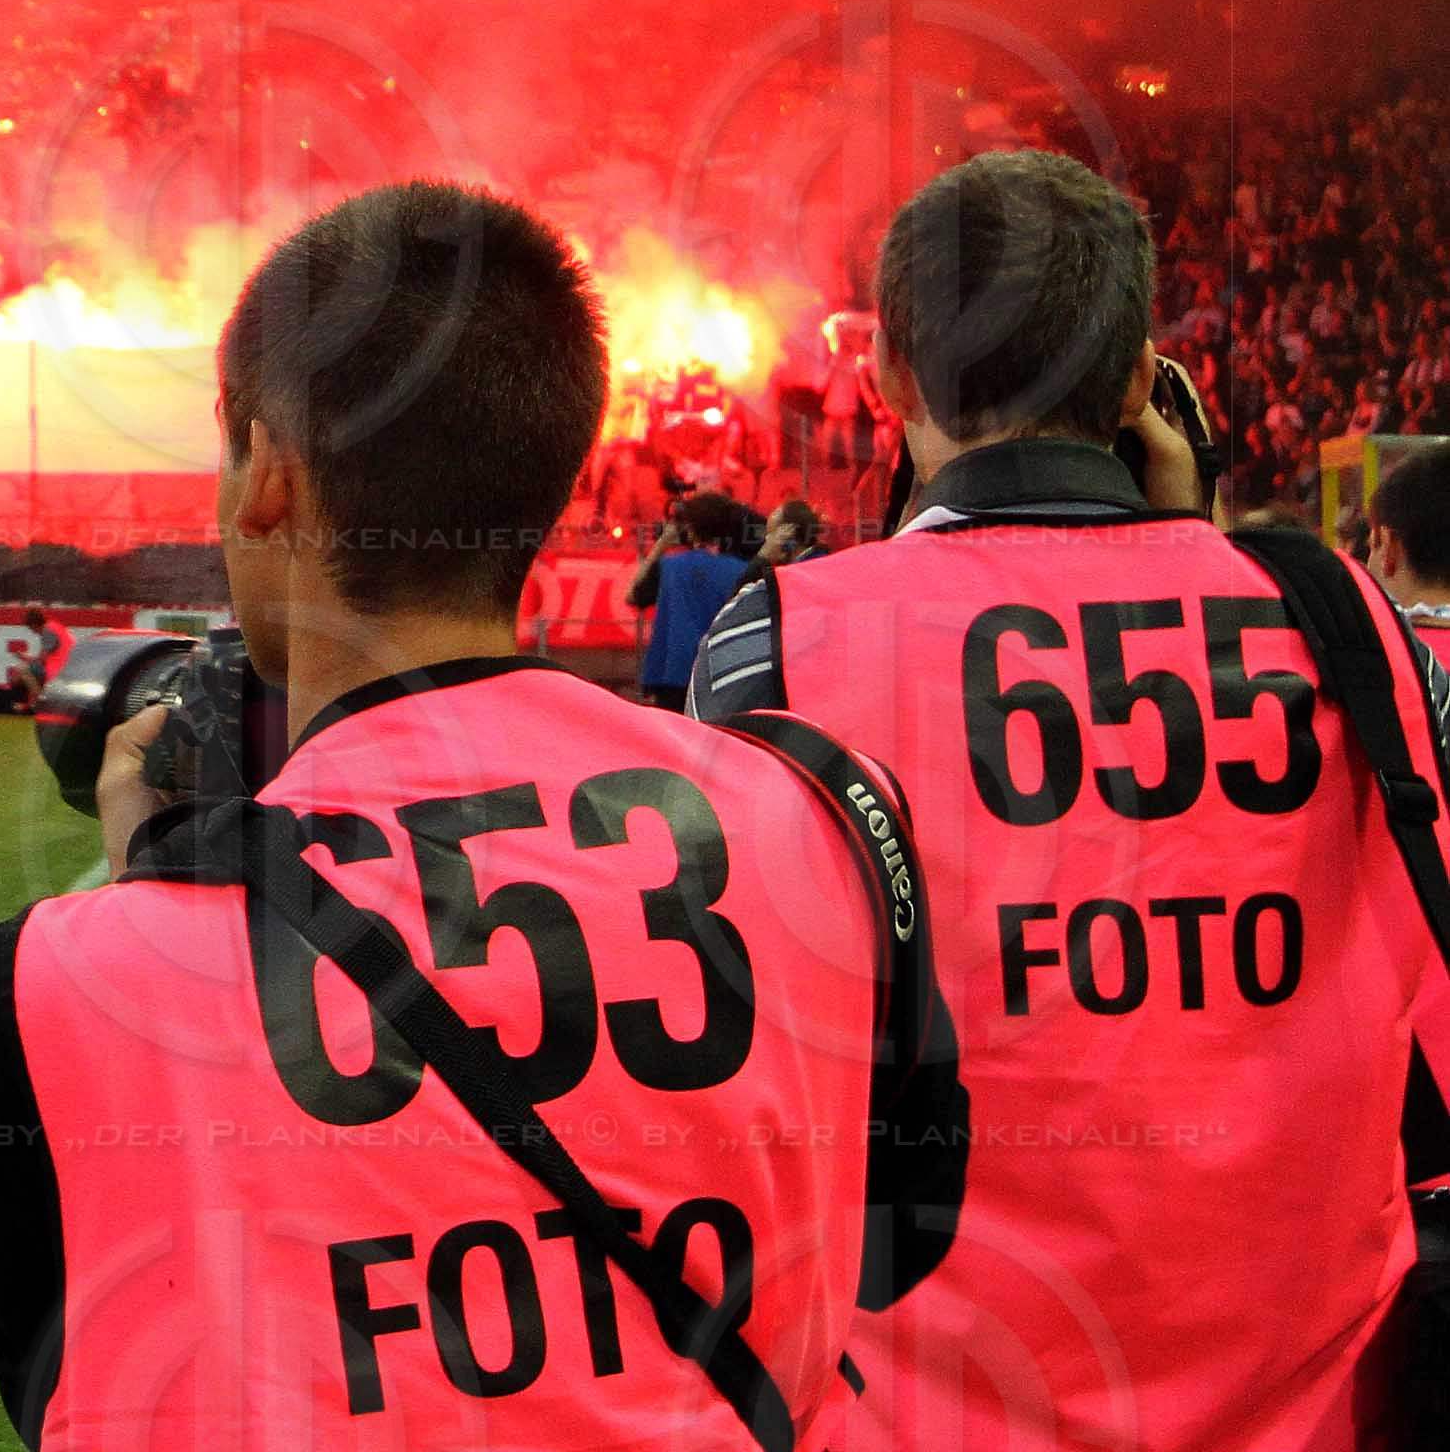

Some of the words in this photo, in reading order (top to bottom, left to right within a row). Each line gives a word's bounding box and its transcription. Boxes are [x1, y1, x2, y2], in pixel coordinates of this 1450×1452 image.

[961, 596, 1323, 828] 655
[246, 767, 756, 1127] 653
[846, 782, 915, 943] Canon
[997, 892, 1304, 1017] FOTO
[328, 1196, 755, 1417] FOTO
